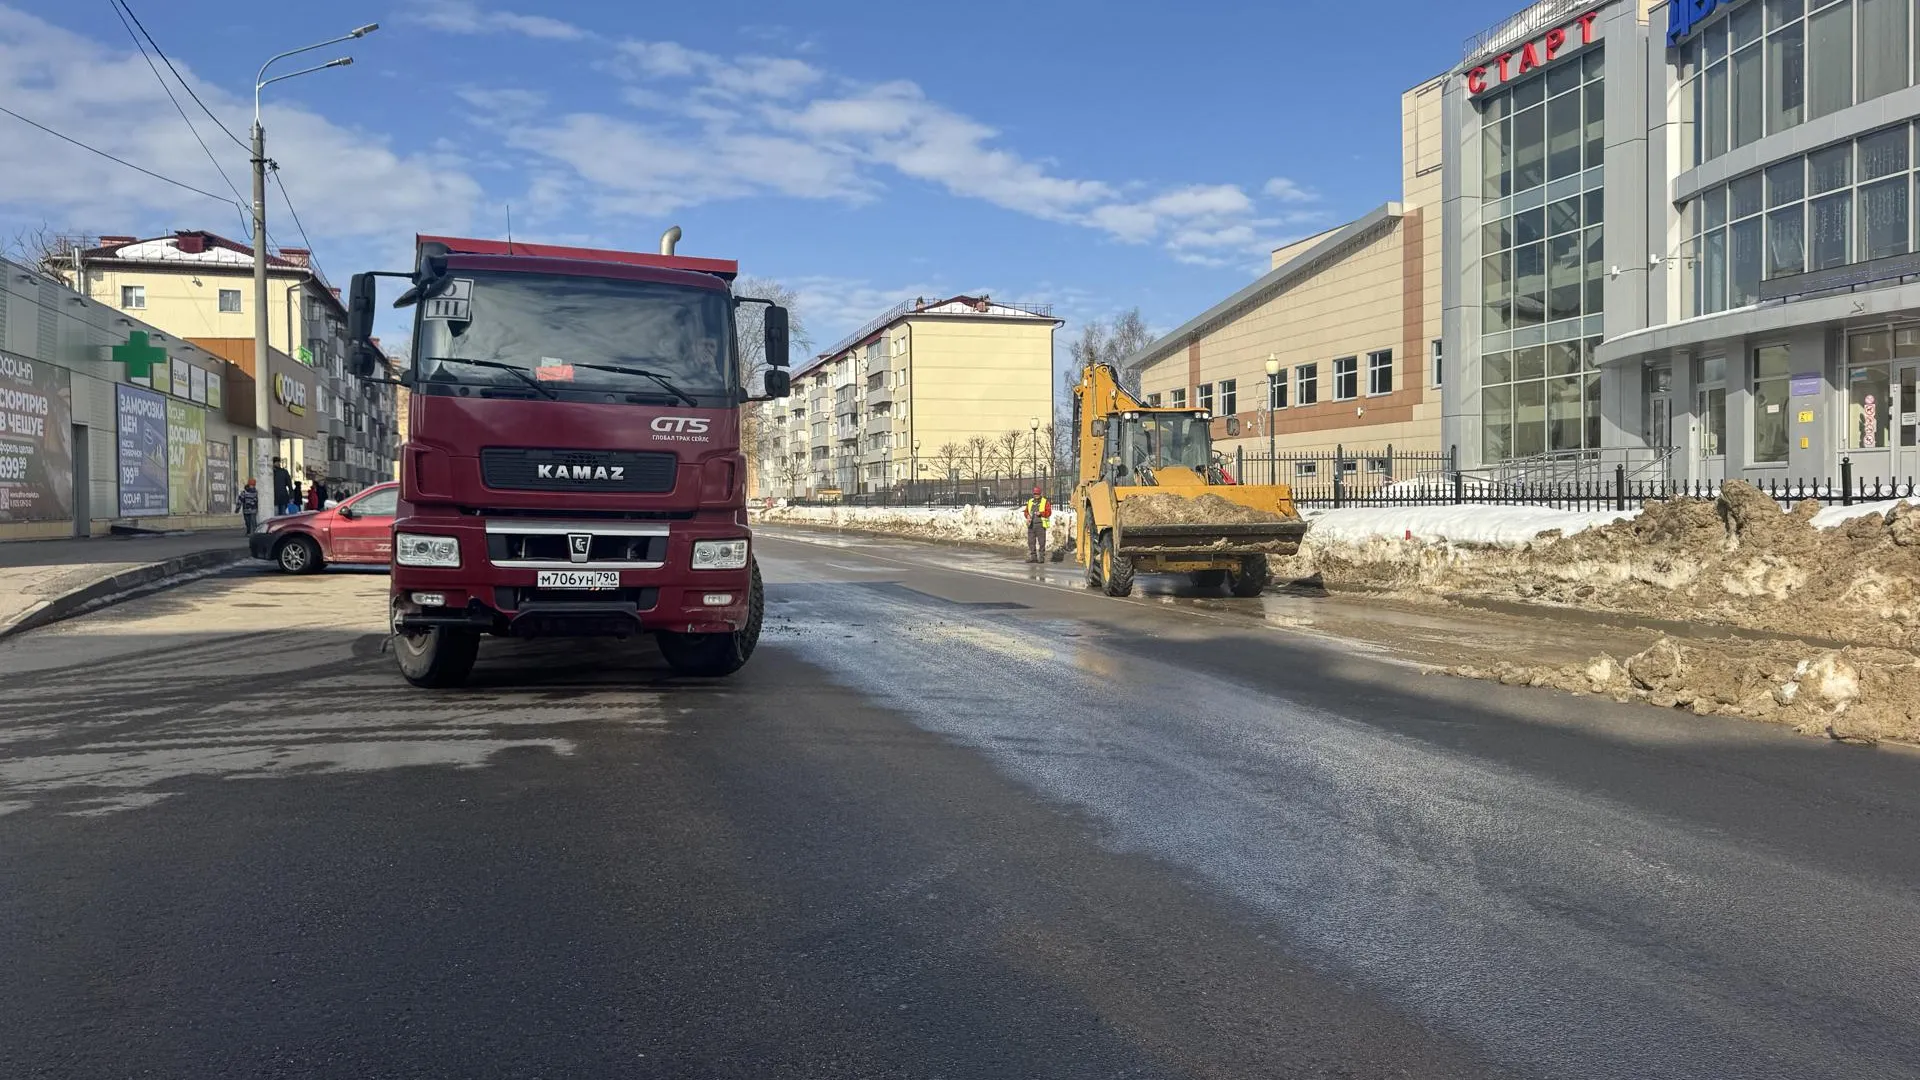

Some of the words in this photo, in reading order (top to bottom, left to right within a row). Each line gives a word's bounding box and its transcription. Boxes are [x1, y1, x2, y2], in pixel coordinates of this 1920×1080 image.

[1468, 11, 1598, 94] СТАРТ
[0, 387, 48, 415] СЮРПРИЗ
[120, 394, 165, 420] ЗАМОРОЗКА
[0, 411, 6, 431] В
[8, 412, 44, 436] ЧЕШУЕ
[121, 414, 138, 436] ЦЕН
[651, 416, 711, 433] GTS
[691, 435, 709, 443] СЕЙЛС
[0, 456, 19, 479] 699
[123, 466, 134, 485] 199
[538, 464, 624, 480] KAMAZ
[597, 572, 617, 582] 790
